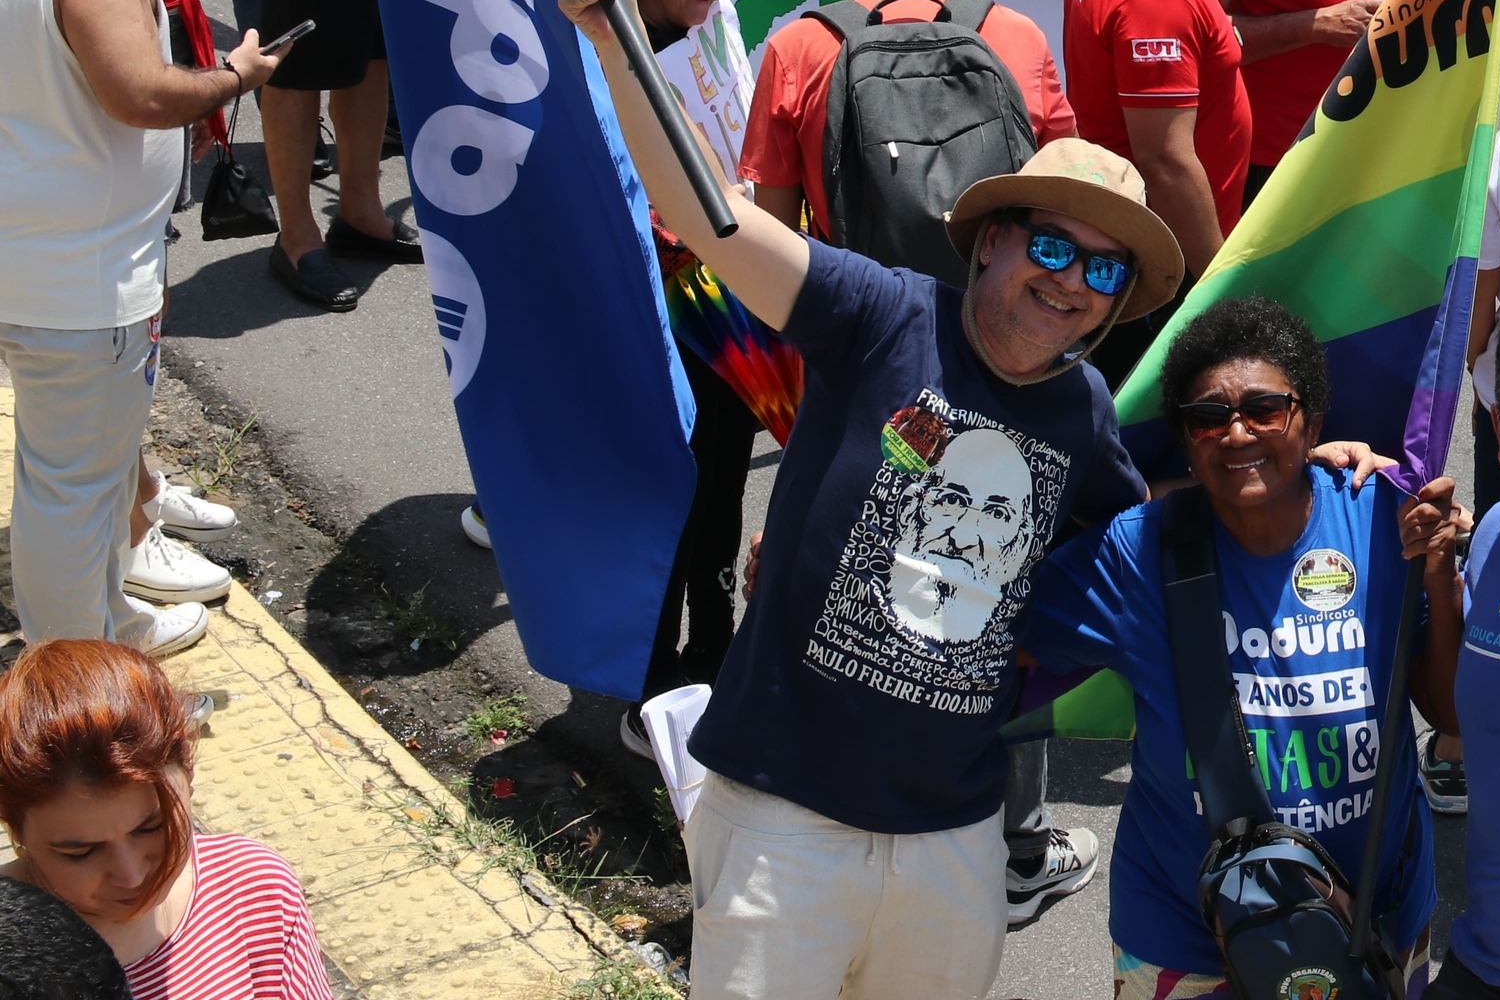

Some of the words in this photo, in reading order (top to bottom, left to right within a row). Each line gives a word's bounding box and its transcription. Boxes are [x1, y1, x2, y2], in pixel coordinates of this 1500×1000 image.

[1134, 41, 1174, 56] CUT
[1296, 609, 1356, 626] Sindicato
[805, 638, 859, 679] PAULO
[857, 663, 926, 705] FREIRE
[929, 689, 961, 714] 100
[958, 695, 995, 715] ANOS
[1248, 682, 1315, 708] ANOS
[1323, 676, 1357, 704] DE
[1351, 726, 1377, 773] &
[1280, 976, 1292, 994] POVO
[1291, 967, 1337, 984] ORGANIZADO
